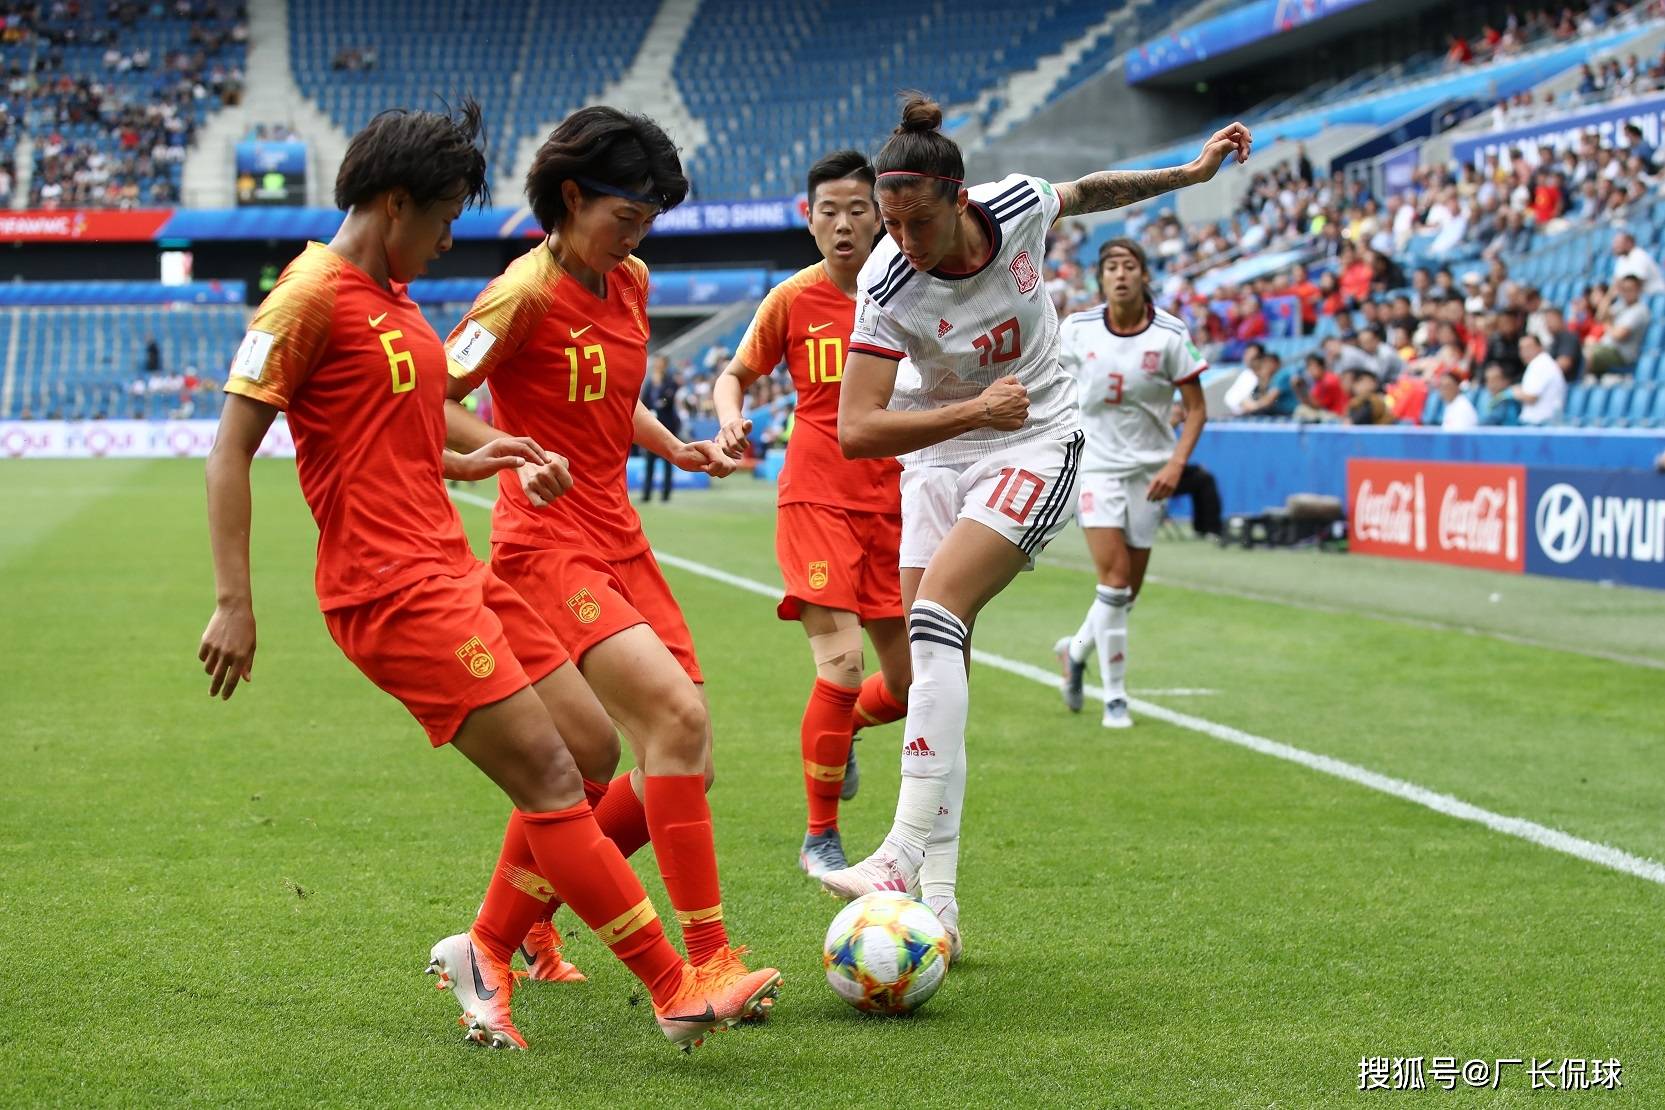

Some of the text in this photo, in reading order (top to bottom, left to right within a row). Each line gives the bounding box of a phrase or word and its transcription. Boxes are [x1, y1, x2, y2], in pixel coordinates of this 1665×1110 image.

[704, 204, 730, 230] TO
[730, 202, 784, 228] SHINE
[379, 330, 416, 394] 6
[804, 337, 843, 383] 10
[972, 316, 1022, 367] 10
[564, 343, 607, 402] 13
[1103, 372, 1124, 405] 3
[986, 466, 1047, 526] 10
[459, 639, 480, 658] CFA
